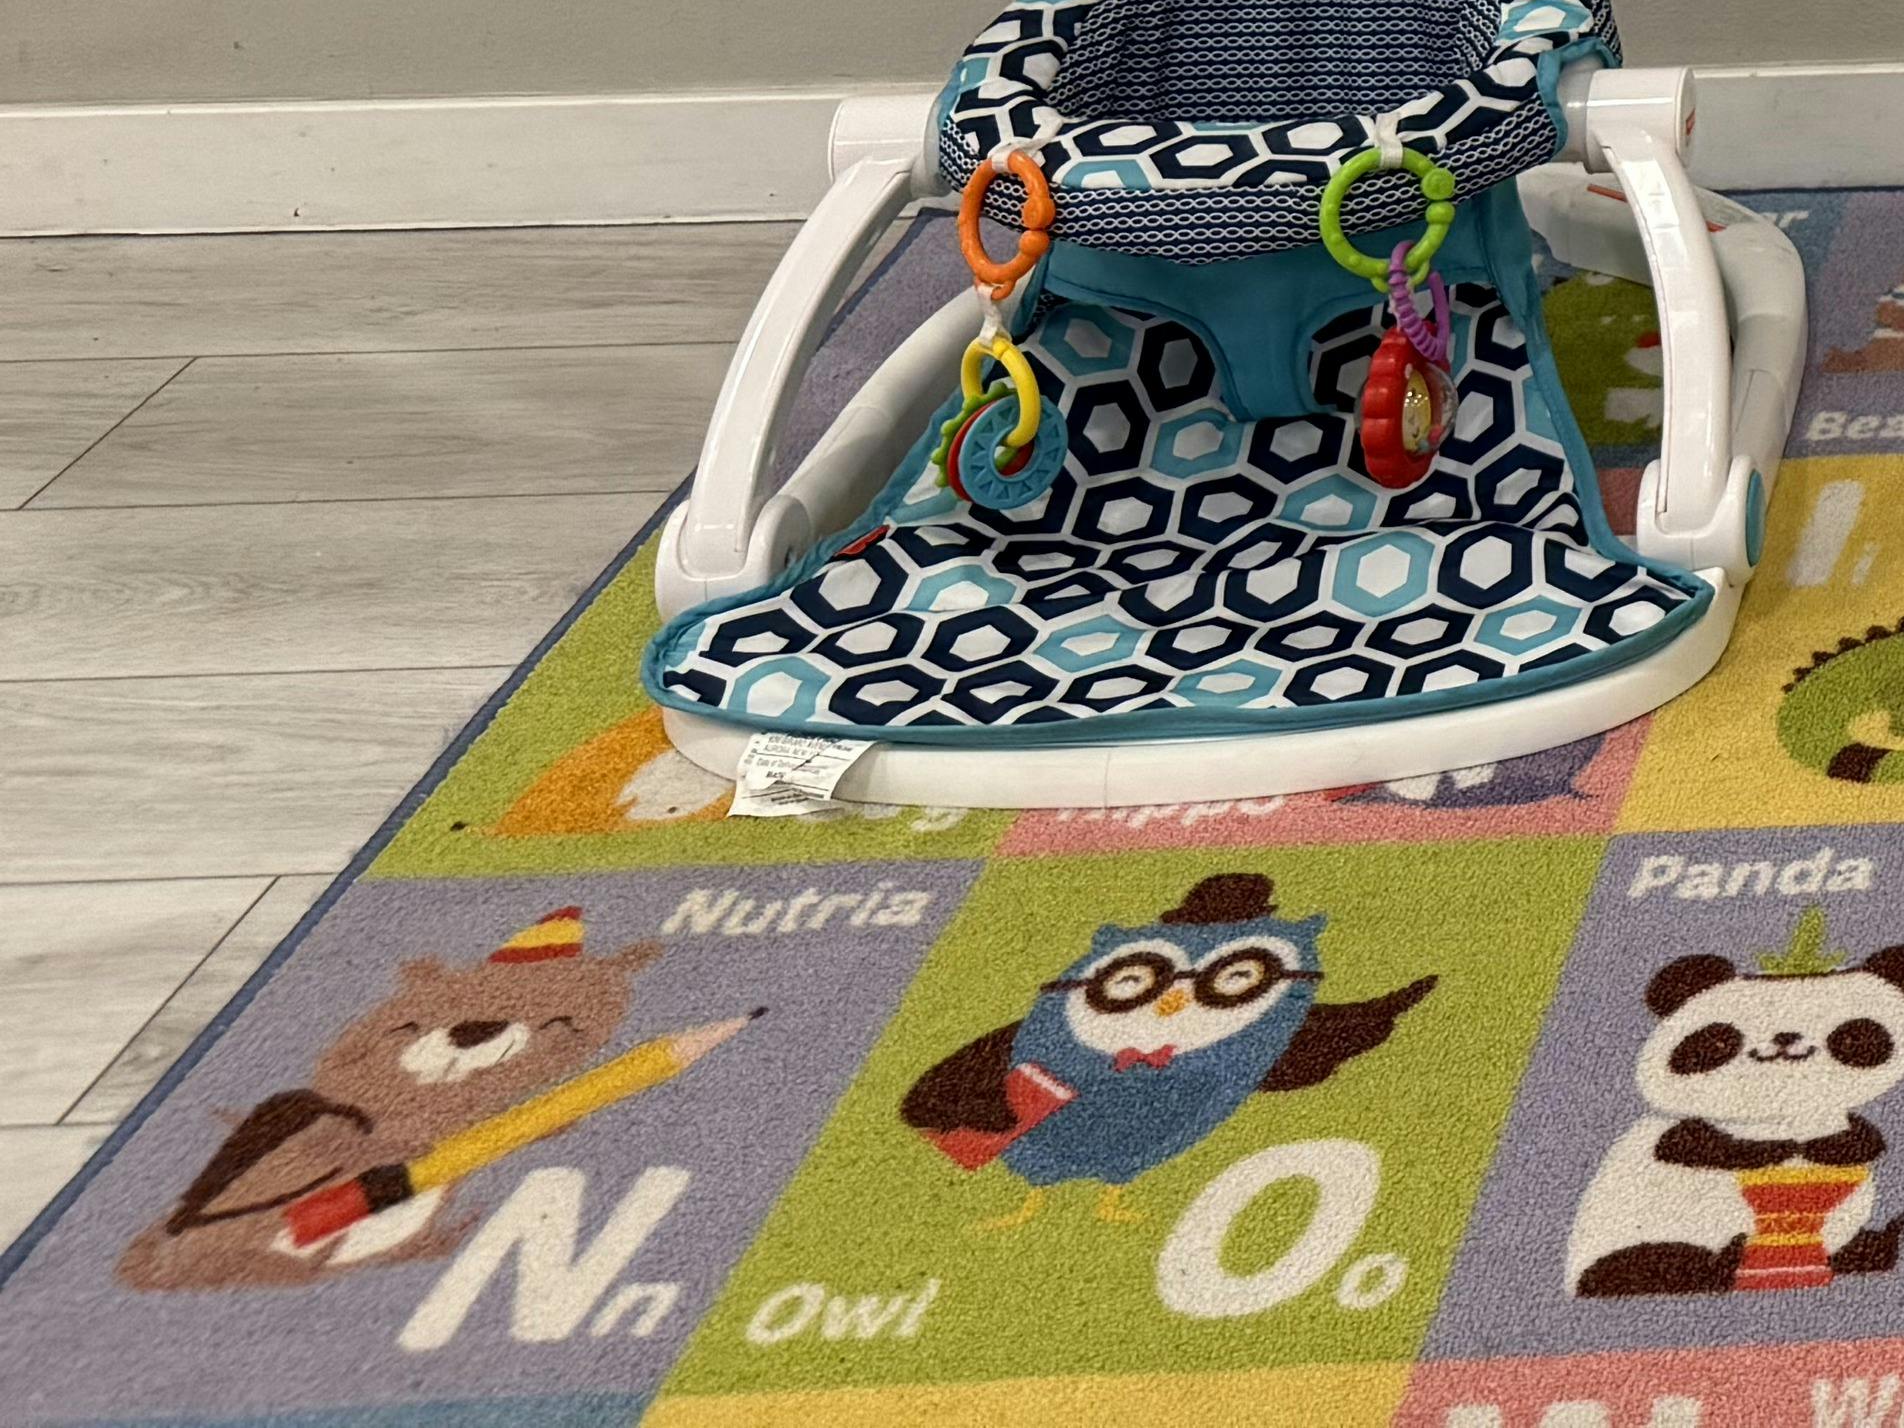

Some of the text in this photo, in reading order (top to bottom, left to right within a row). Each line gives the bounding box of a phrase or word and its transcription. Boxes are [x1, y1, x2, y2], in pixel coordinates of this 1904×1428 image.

[1629, 850, 1876, 902] Panda
[661, 883, 935, 938] Nutria
[744, 1278, 942, 1345] Owl
